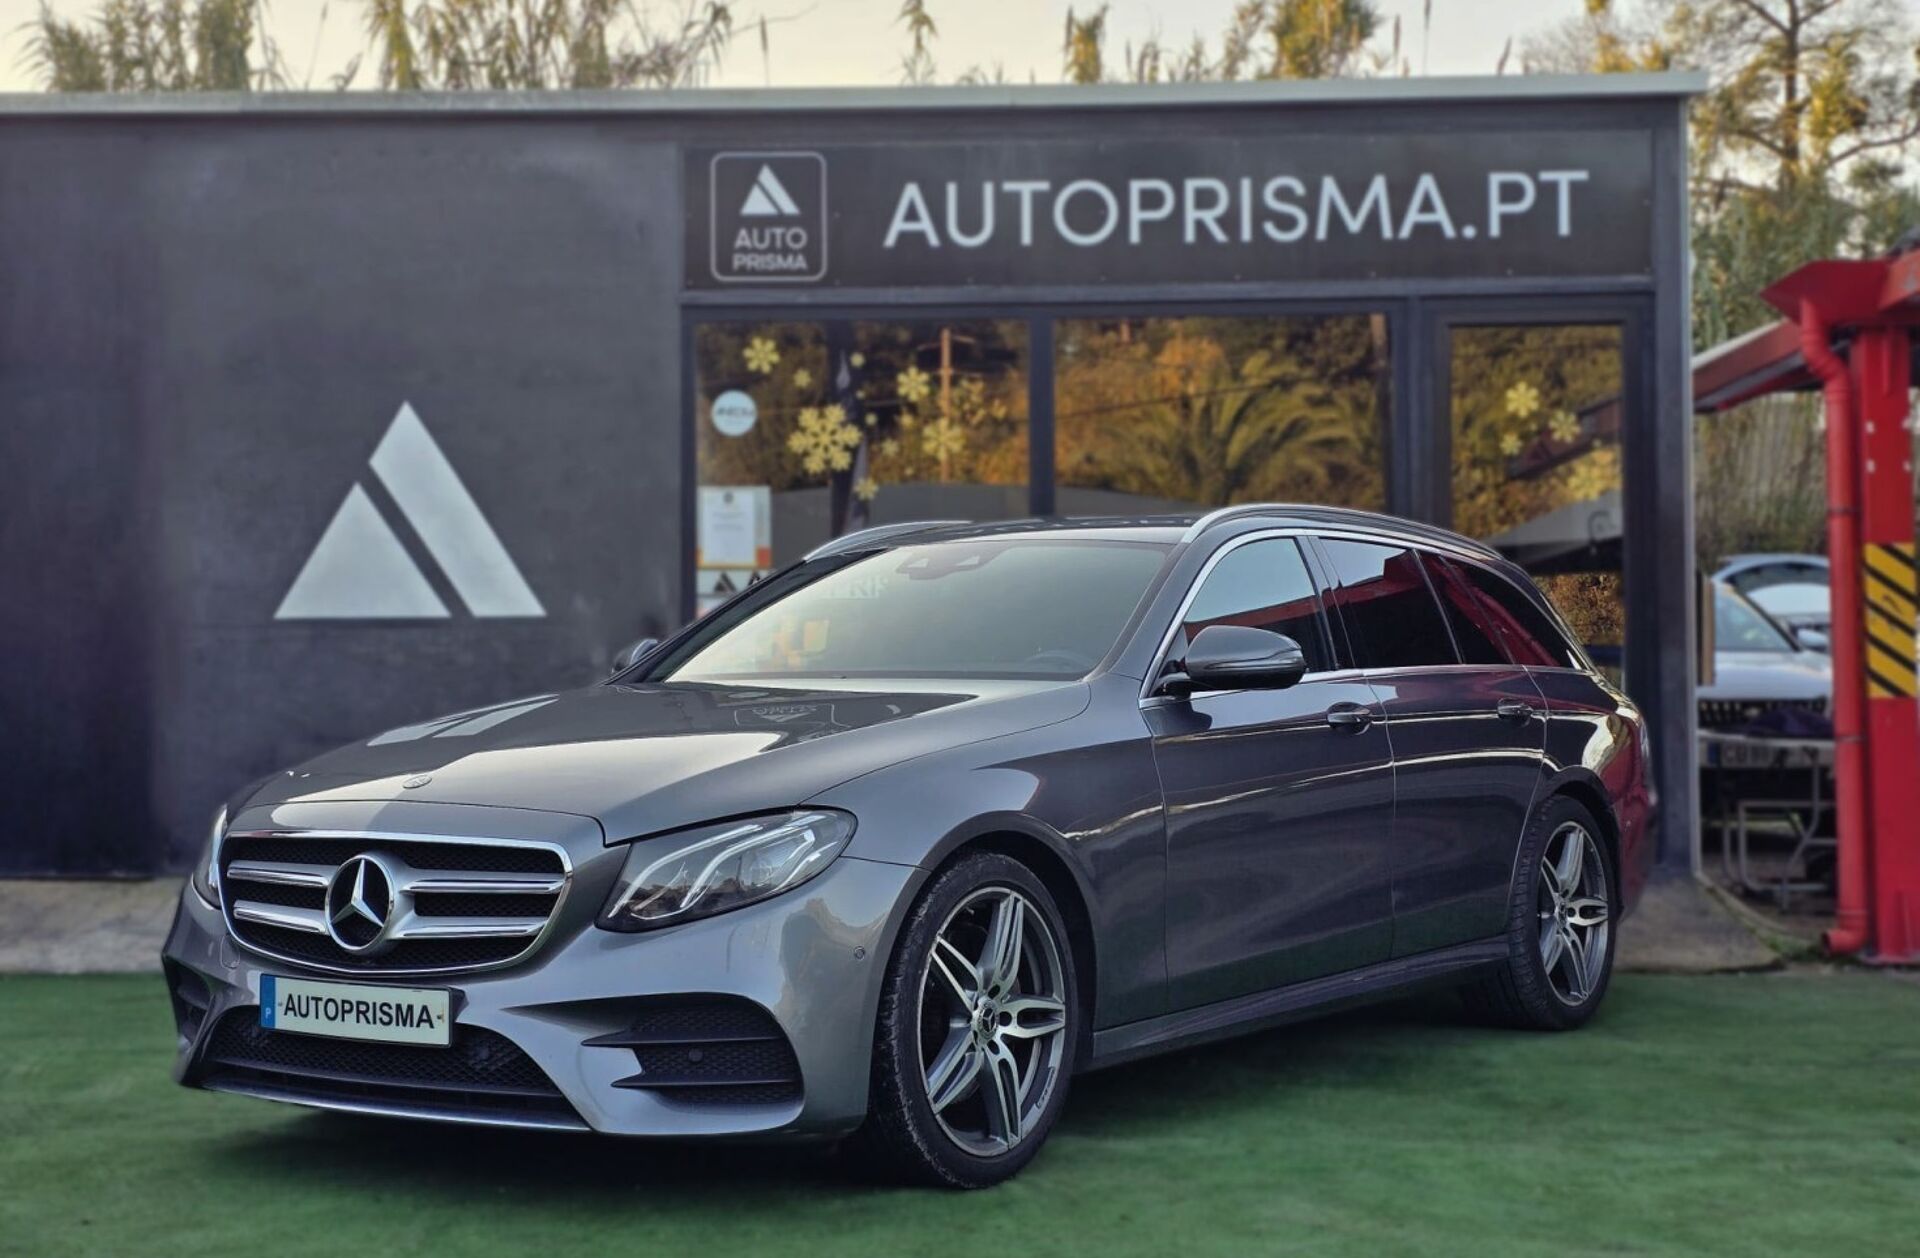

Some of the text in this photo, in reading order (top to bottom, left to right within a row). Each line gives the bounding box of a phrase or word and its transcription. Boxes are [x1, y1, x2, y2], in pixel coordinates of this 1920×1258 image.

[884, 170, 1589, 248] AUTOPRISMA.PT
[734, 227, 808, 250] AUTO
[732, 252, 808, 270] PRISMA
[284, 993, 435, 1029] AUTOPRISMA
